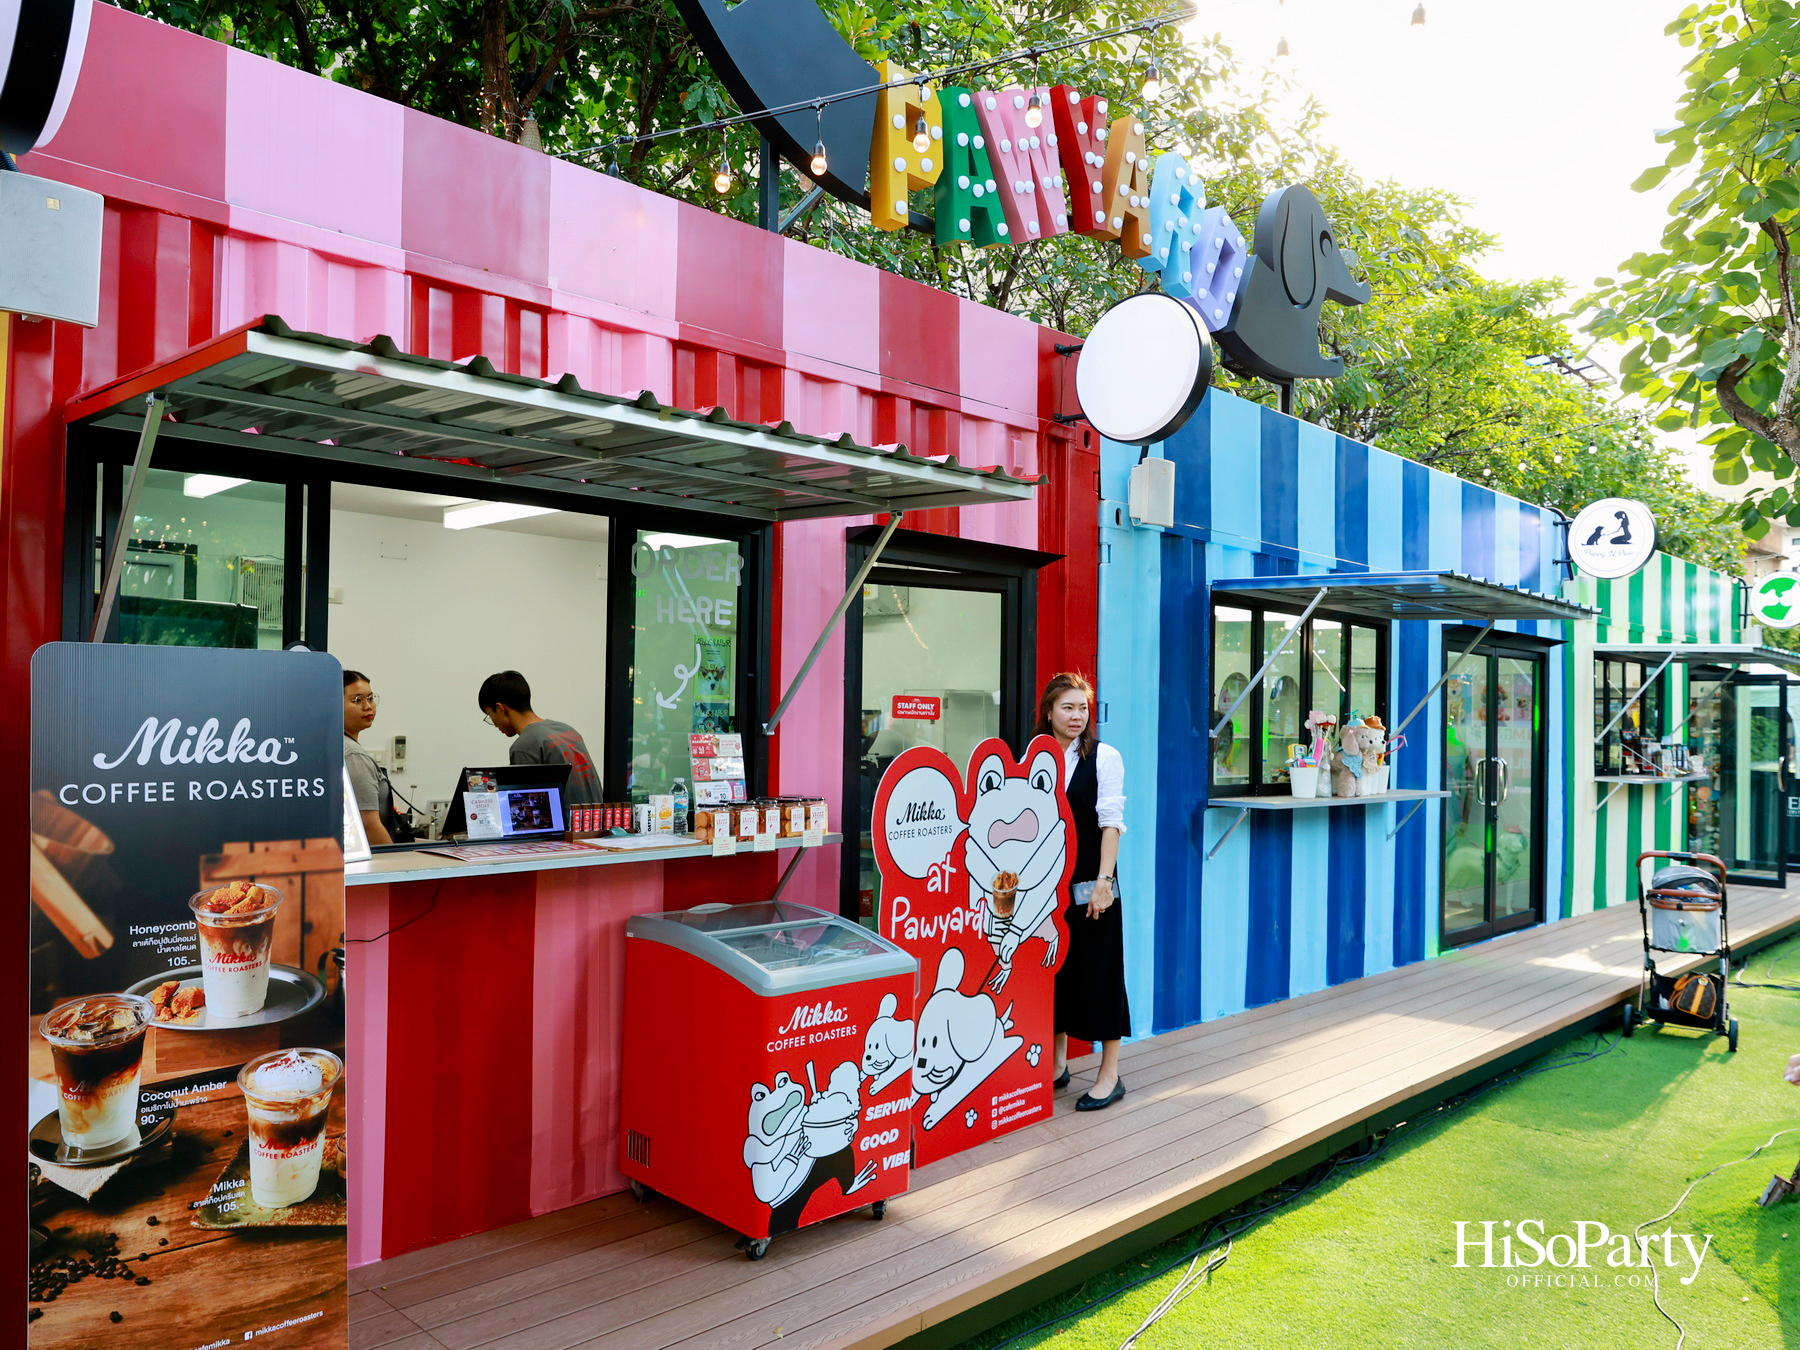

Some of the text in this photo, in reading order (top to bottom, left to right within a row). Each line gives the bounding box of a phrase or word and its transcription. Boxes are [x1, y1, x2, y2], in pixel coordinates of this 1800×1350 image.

[870, 60, 1247, 332] PAWYARD
[631, 541, 744, 586] ORDER
[656, 595, 733, 625] HERE
[897, 702, 917, 710] STAFF
[93, 716, 298, 769] Mikka
[59, 778, 326, 806] COFFEE ROASTERS
[896, 801, 945, 825] Mikka
[888, 825, 953, 841] COFFEE ROASTERS
[927, 853, 956, 894] at
[129, 921, 197, 936] Honeycomb
[891, 897, 988, 943] Pawyard
[228, 961, 262, 972] ROASTERS
[778, 1000, 848, 1035] Mikka
[766, 1025, 857, 1053] COFFEE ROASTERS
[141, 1081, 227, 1103] Coconut Amber
[254, 1148, 278, 1160] COFFEE
[280, 1142, 318, 1159] ROASTERS
[860, 1128, 899, 1151] GOOD
[213, 1178, 245, 1193] Mikka
[255, 1310, 324, 1337] mikkacoffeeroasters
